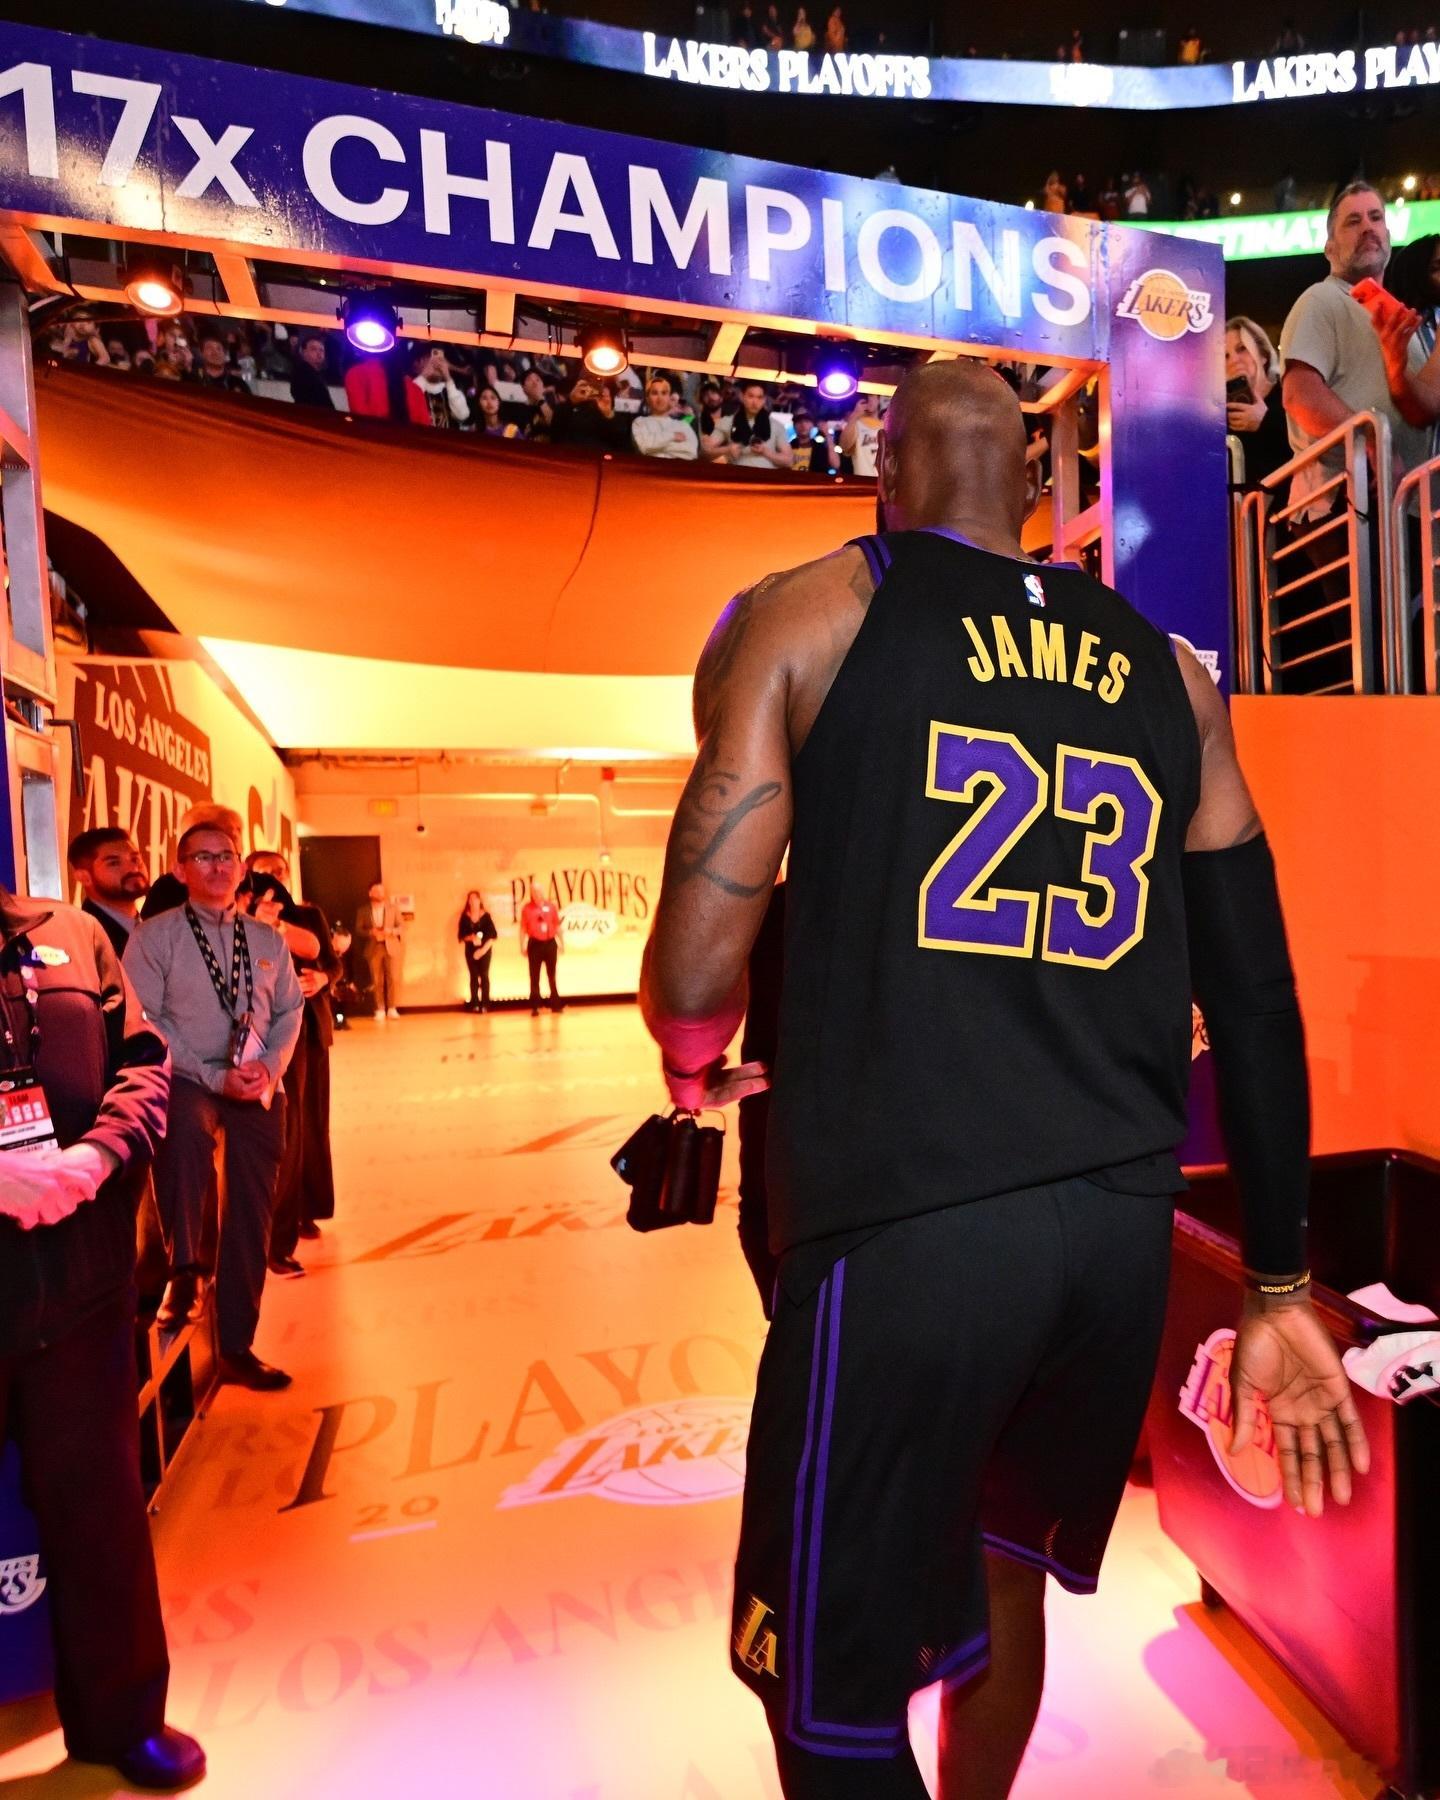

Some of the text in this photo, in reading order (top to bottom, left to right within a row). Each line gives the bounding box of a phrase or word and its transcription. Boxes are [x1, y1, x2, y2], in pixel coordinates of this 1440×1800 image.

[643, 32, 932, 99] LAKERS PLAYOFFS
[1232, 50, 1358, 103] LAKERS
[302, 114, 1093, 327] CHAMPIONS
[1124, 284, 1207, 329] LAKERS
[961, 615, 1131, 704] JAMES
[94, 681, 209, 787] LOS ANGELES
[918, 720, 1163, 971] 23
[1260, 1284, 1295, 1294] AKRON
[355, 1496, 440, 1527] 20
[734, 1596, 779, 1678] LA
